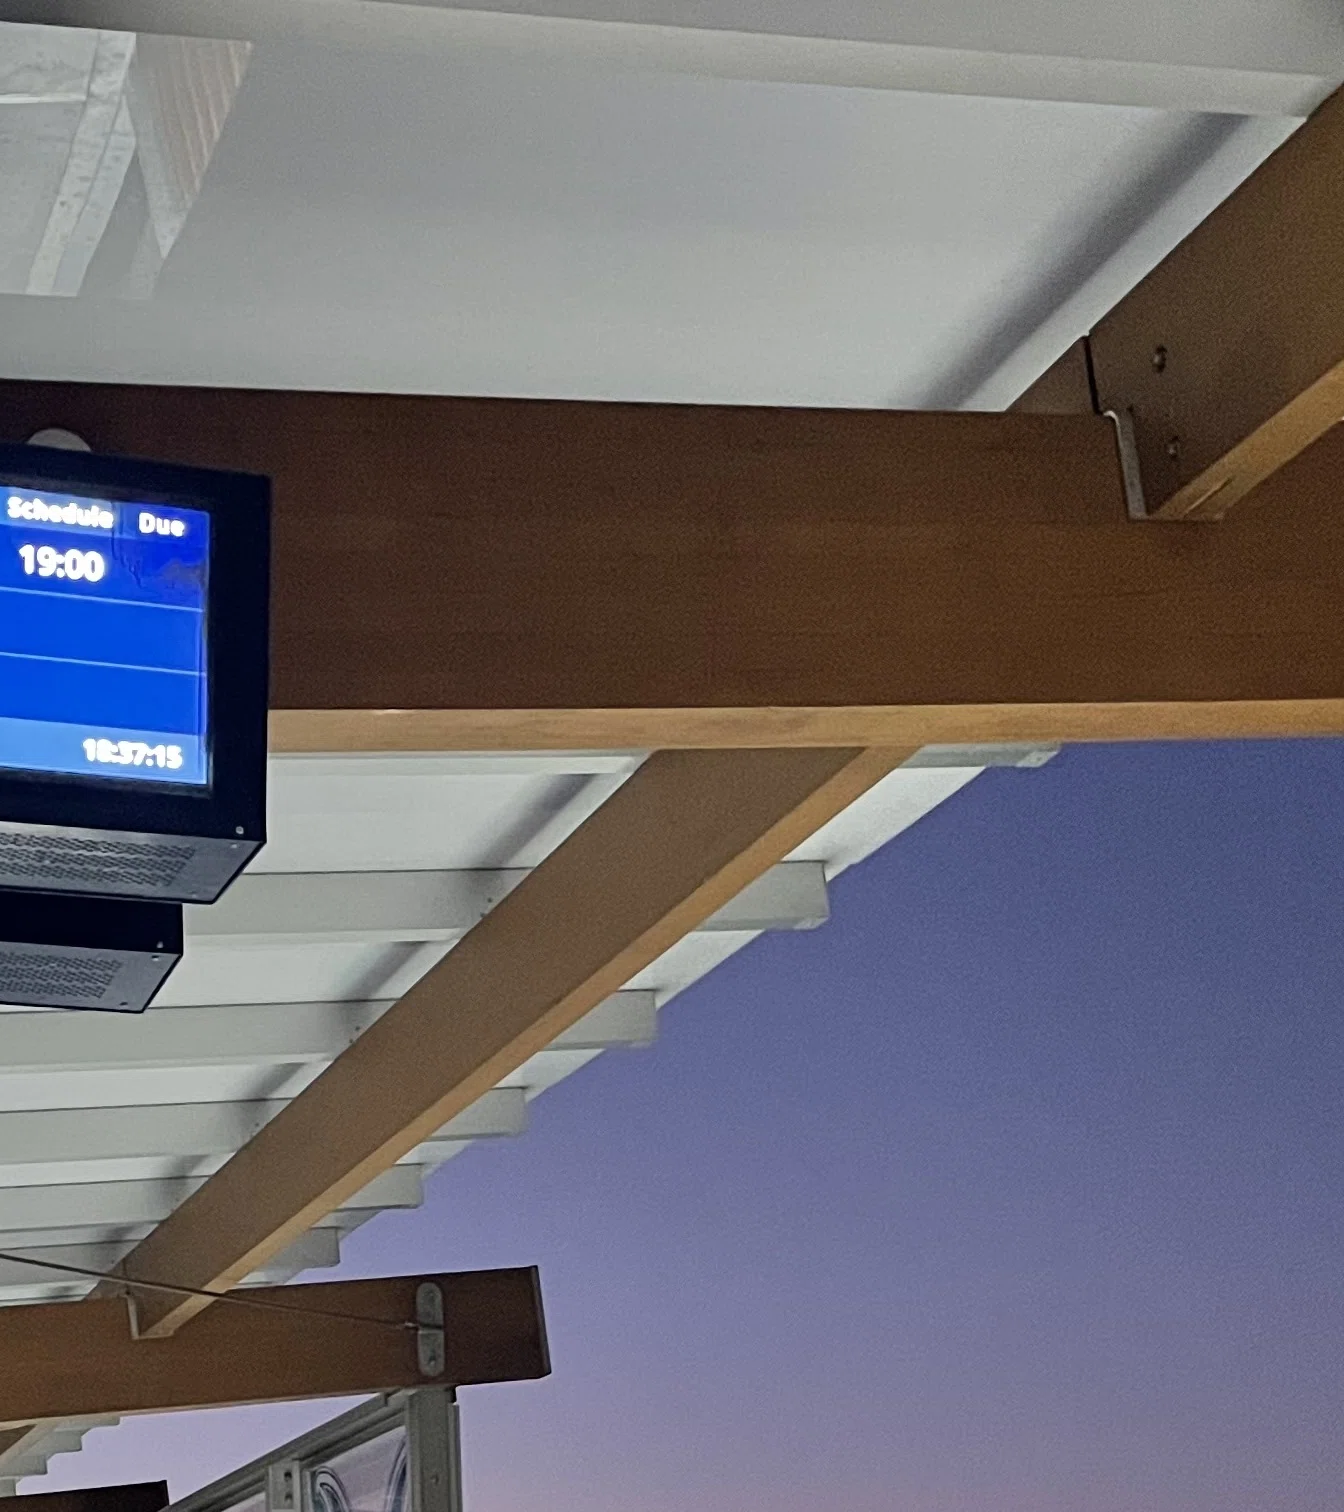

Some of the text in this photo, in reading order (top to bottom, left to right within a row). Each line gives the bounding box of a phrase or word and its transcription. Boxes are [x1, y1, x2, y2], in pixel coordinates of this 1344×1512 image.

[7, 496, 114, 528] Schedule
[138, 512, 185, 537] Due
[19, 544, 106, 582] 19:00
